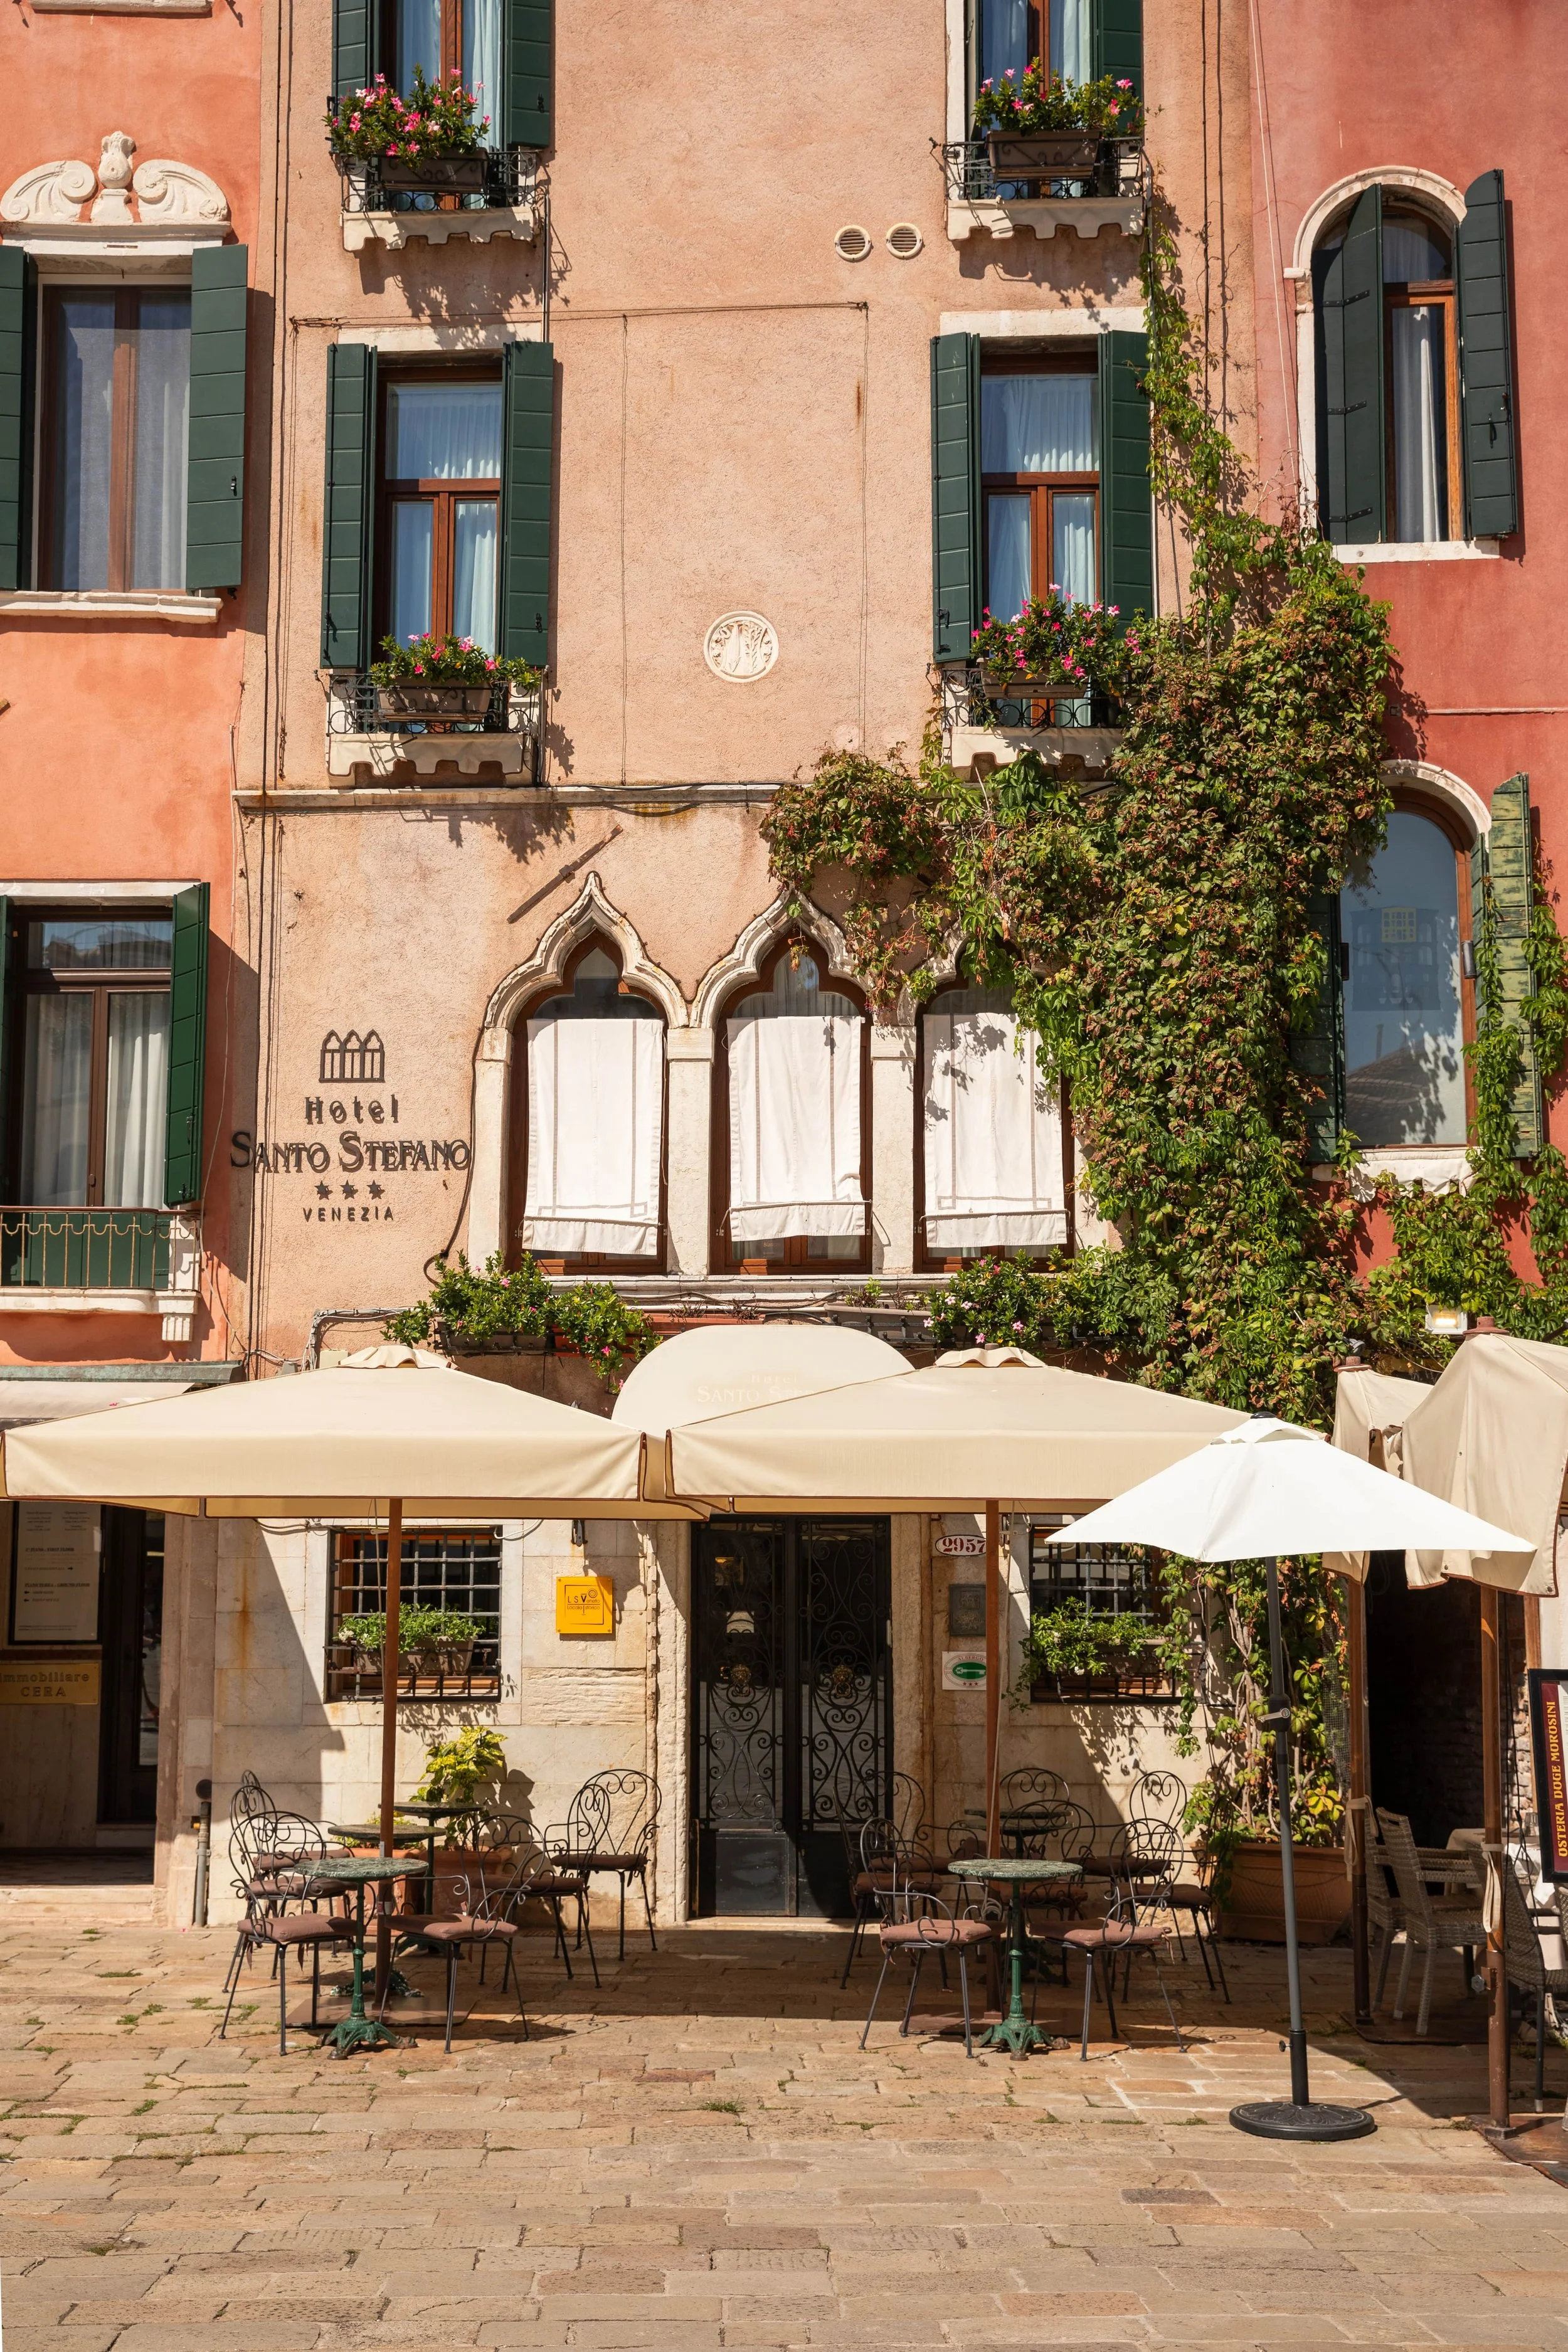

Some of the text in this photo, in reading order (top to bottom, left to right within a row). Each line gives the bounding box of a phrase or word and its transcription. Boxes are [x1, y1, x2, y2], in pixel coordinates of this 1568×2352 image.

[305, 1094, 398, 1123] Hotel
[230, 1130, 470, 1172] SANTO STEFANO
[303, 1207, 394, 1222] VENEZIA
[751, 1374, 797, 1384] Hotel
[697, 1385, 760, 1402] SANTO
[942, 1537, 986, 1553] 2957
[21, 1687, 66, 1697] CERA
[1546, 1702, 1568, 1857] OSTERIA DOGE MOROSINI
